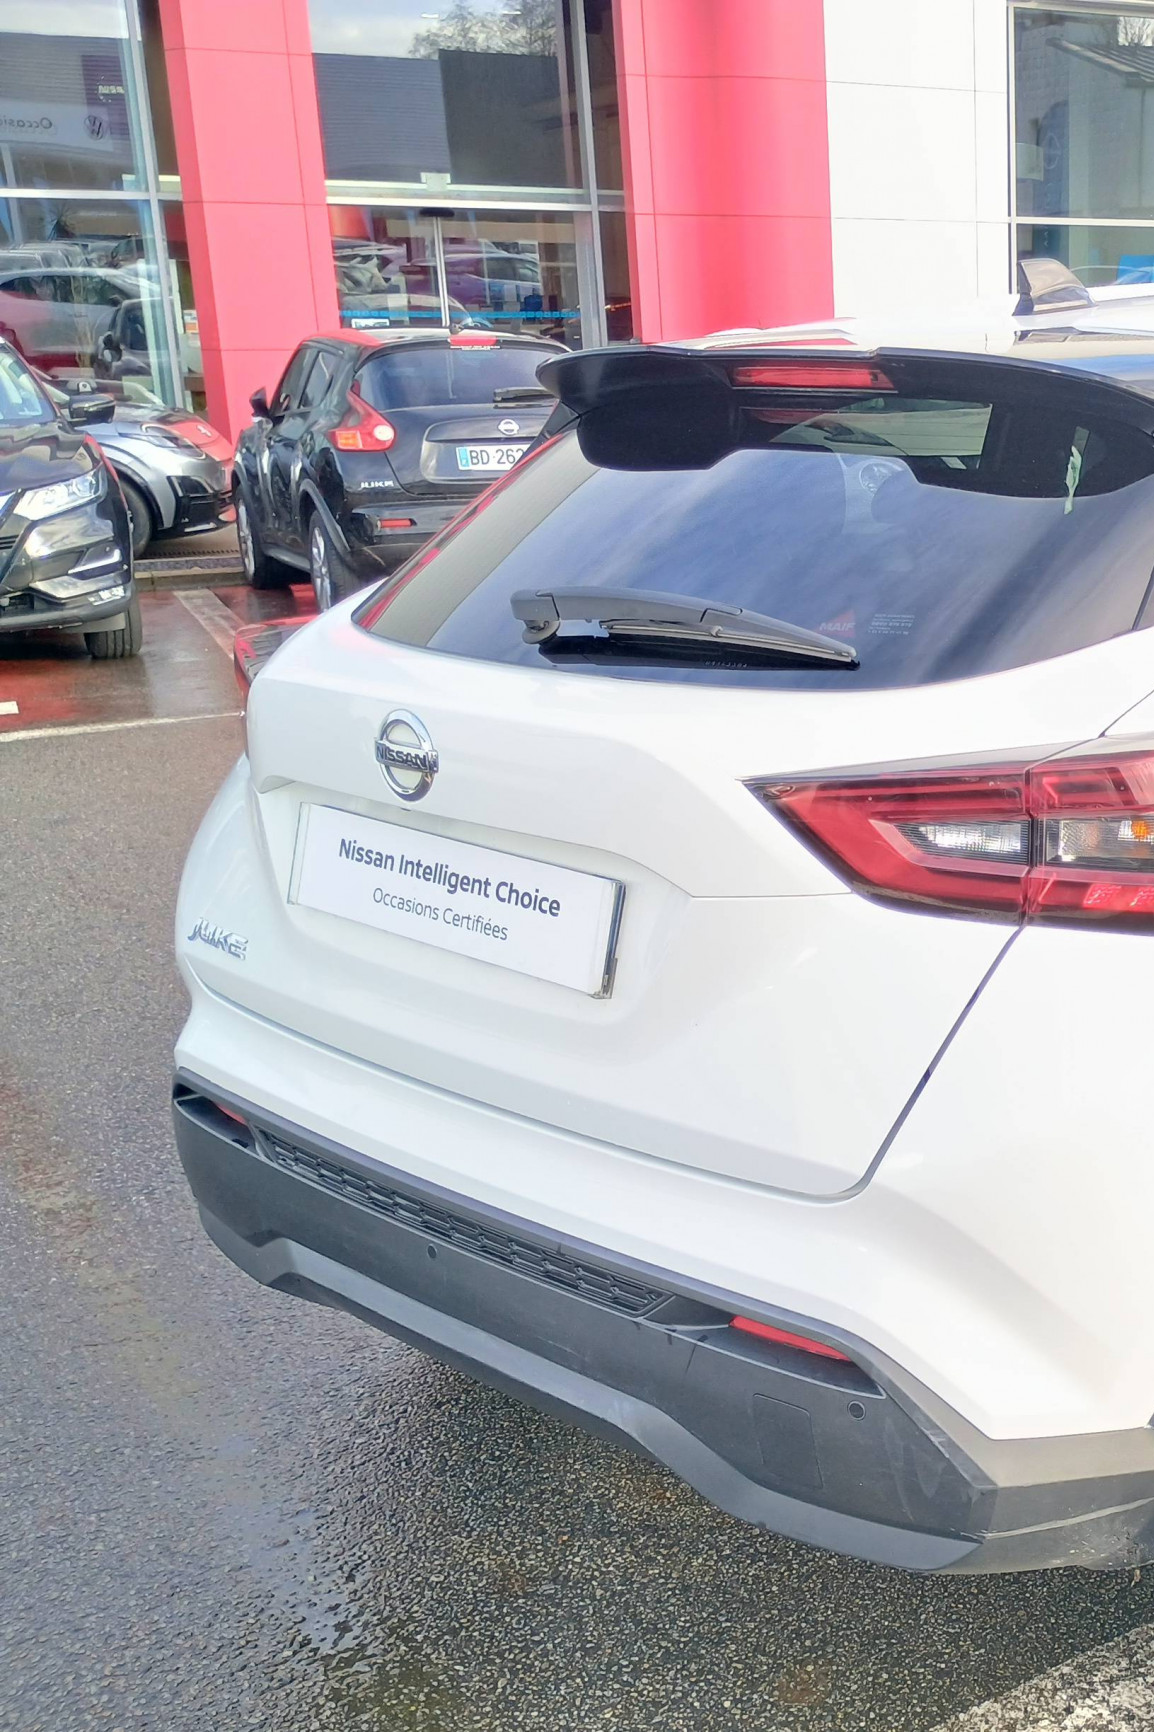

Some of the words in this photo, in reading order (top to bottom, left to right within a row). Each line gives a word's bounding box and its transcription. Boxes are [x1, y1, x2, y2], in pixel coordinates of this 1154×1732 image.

[819, 622, 856, 631] MAIF
[376, 744, 430, 772] NISSAN
[338, 838, 395, 872] Nissan
[398, 854, 491, 899] Intelligent
[495, 880, 561, 917] Choice
[373, 886, 440, 921] Occasions
[442, 908, 509, 941] Certifiées
[187, 918, 249, 961] JUKE
